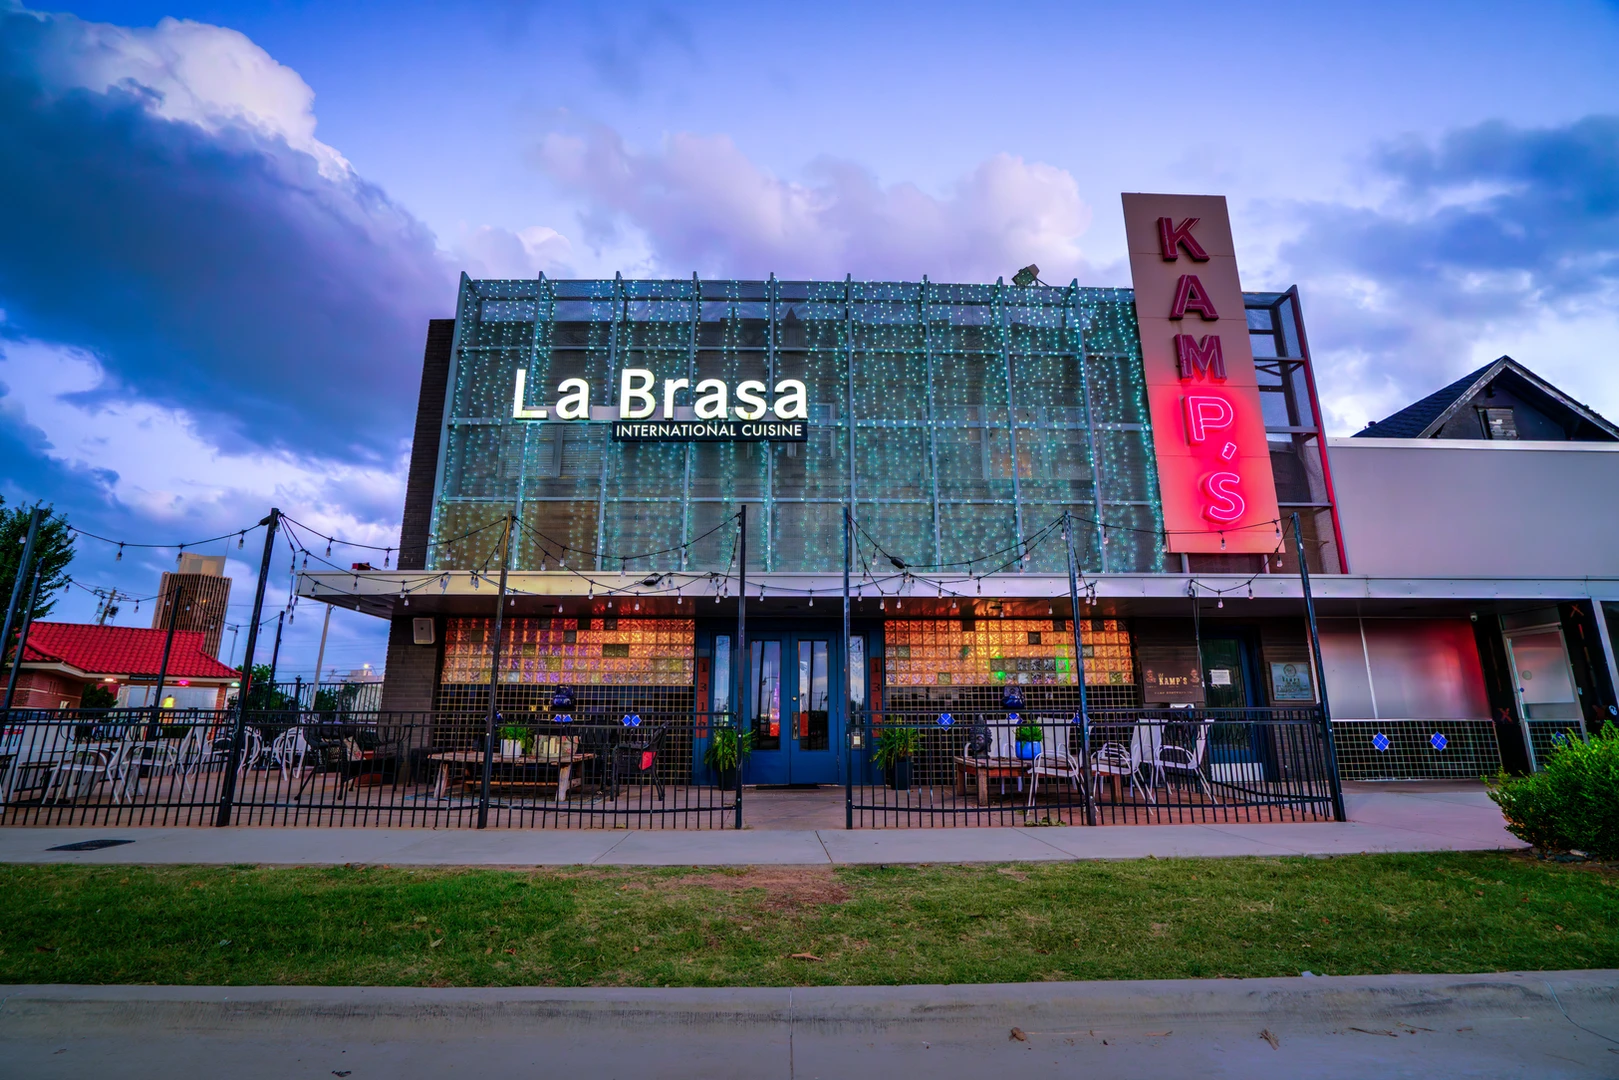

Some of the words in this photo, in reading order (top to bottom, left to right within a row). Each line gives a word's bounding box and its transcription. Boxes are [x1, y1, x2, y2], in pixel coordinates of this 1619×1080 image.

[1157, 216, 1245, 523] KAMP'S
[512, 368, 591, 420] La
[619, 368, 808, 421] Brasa
[615, 423, 737, 438] INTERNATIONAL
[740, 423, 803, 437] CUISINE
[1158, 676, 1188, 685] KAMP'S
